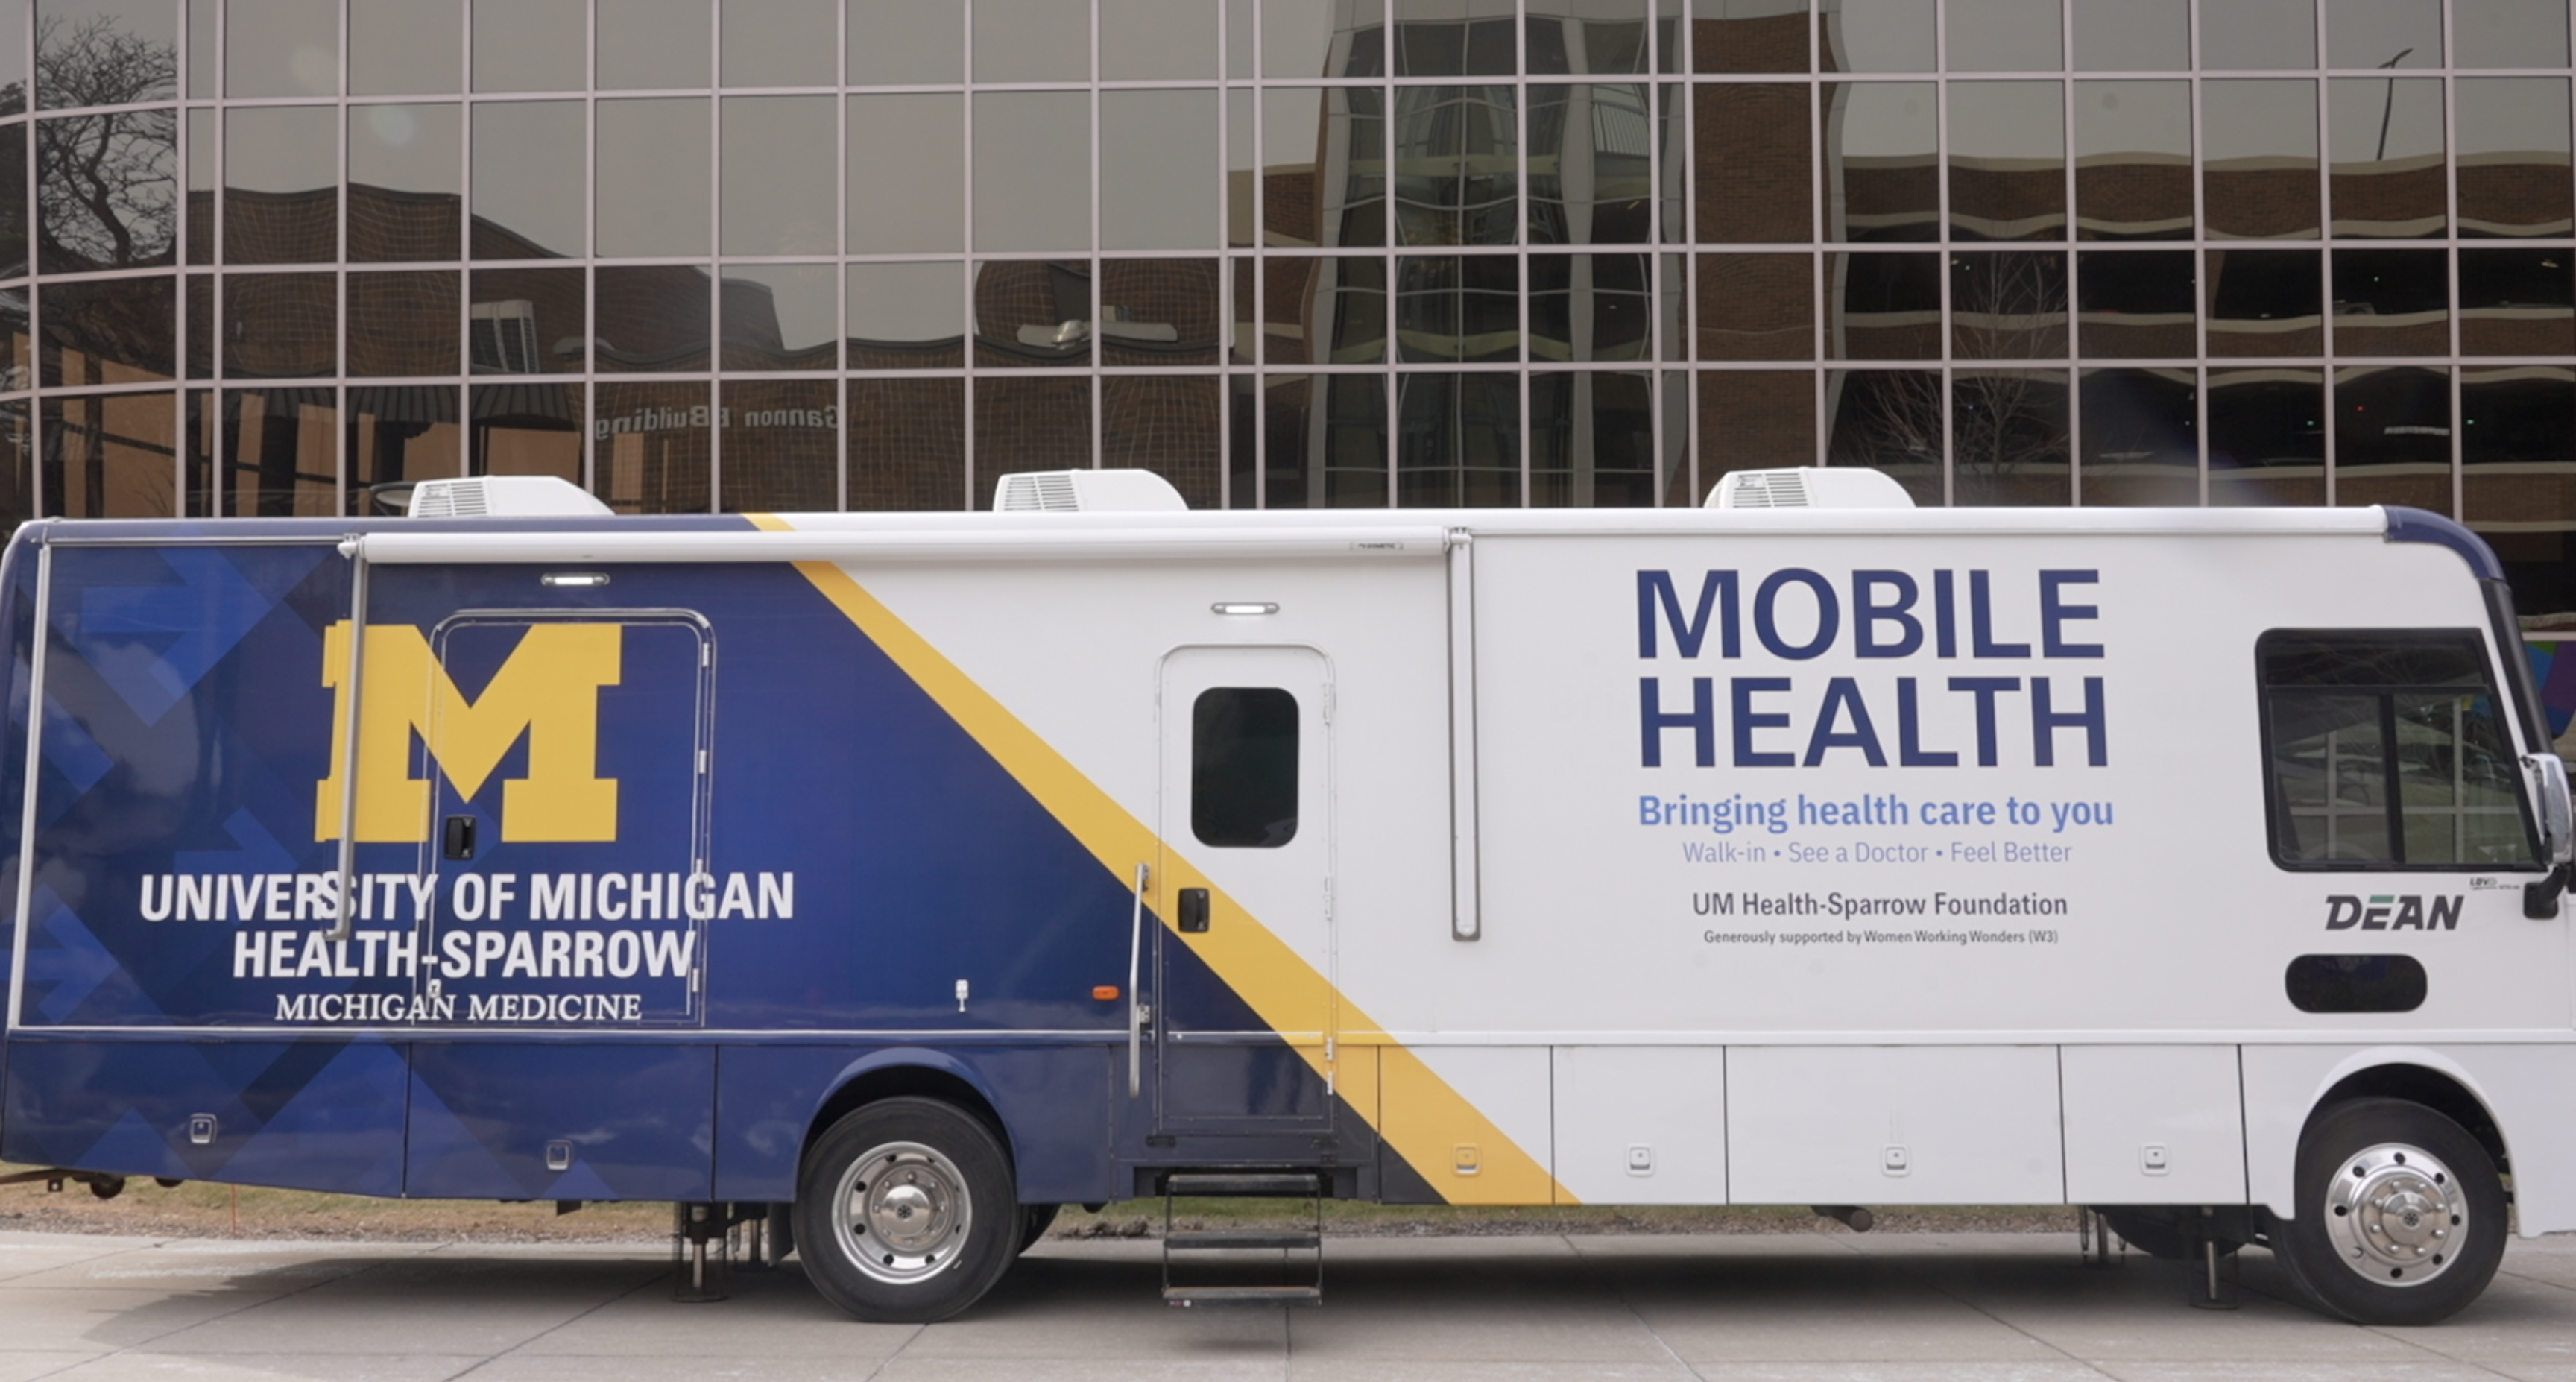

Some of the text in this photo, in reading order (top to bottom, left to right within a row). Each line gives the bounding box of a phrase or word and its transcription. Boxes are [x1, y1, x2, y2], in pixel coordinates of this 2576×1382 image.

[1637, 567, 2105, 660] MOBILE
[315, 619, 622, 842] M
[1640, 676, 2108, 768] HEALTH
[1638, 794, 2114, 834] Bringing health care to you
[1683, 841, 2072, 863] Walk-in See a Doctor Feel Better
[139, 871, 794, 922] UNIVERSITY OF MICHIGAN
[1693, 892, 2068, 921] UM Health-Sparrow Foundation
[2326, 895, 2464, 930] DEAN
[233, 930, 697, 978] HEALTH-SPARROW
[1704, 930, 2059, 945] Generously supported by Women Working Wonders (W3)
[274, 994, 643, 1022] MICHIGAN MEDICINE
